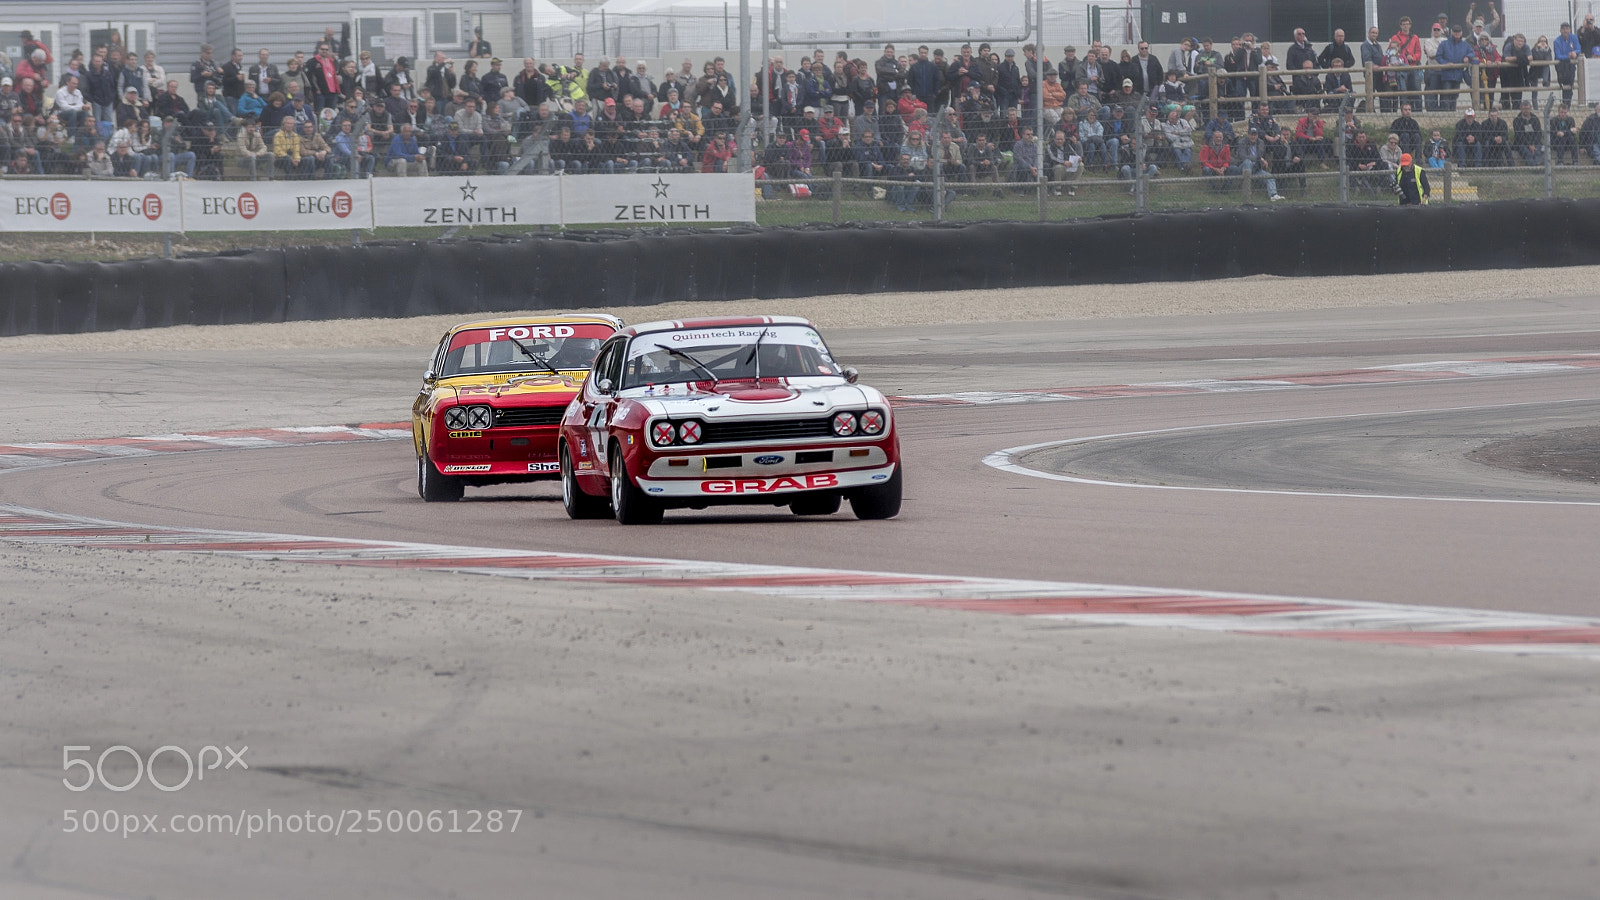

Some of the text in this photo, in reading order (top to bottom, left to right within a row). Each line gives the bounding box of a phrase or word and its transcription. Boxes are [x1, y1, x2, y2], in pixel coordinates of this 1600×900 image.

[15, 197, 49, 216] EFG
[108, 197, 141, 216] EFG
[202, 197, 236, 216] EFG
[297, 195, 330, 215] EFG
[614, 204, 710, 221] ZENITH
[423, 206, 517, 224] ZENITH
[489, 325, 575, 341] FORD
[672, 330, 778, 342] Quinntech Racing
[700, 473, 838, 494] GRAB
